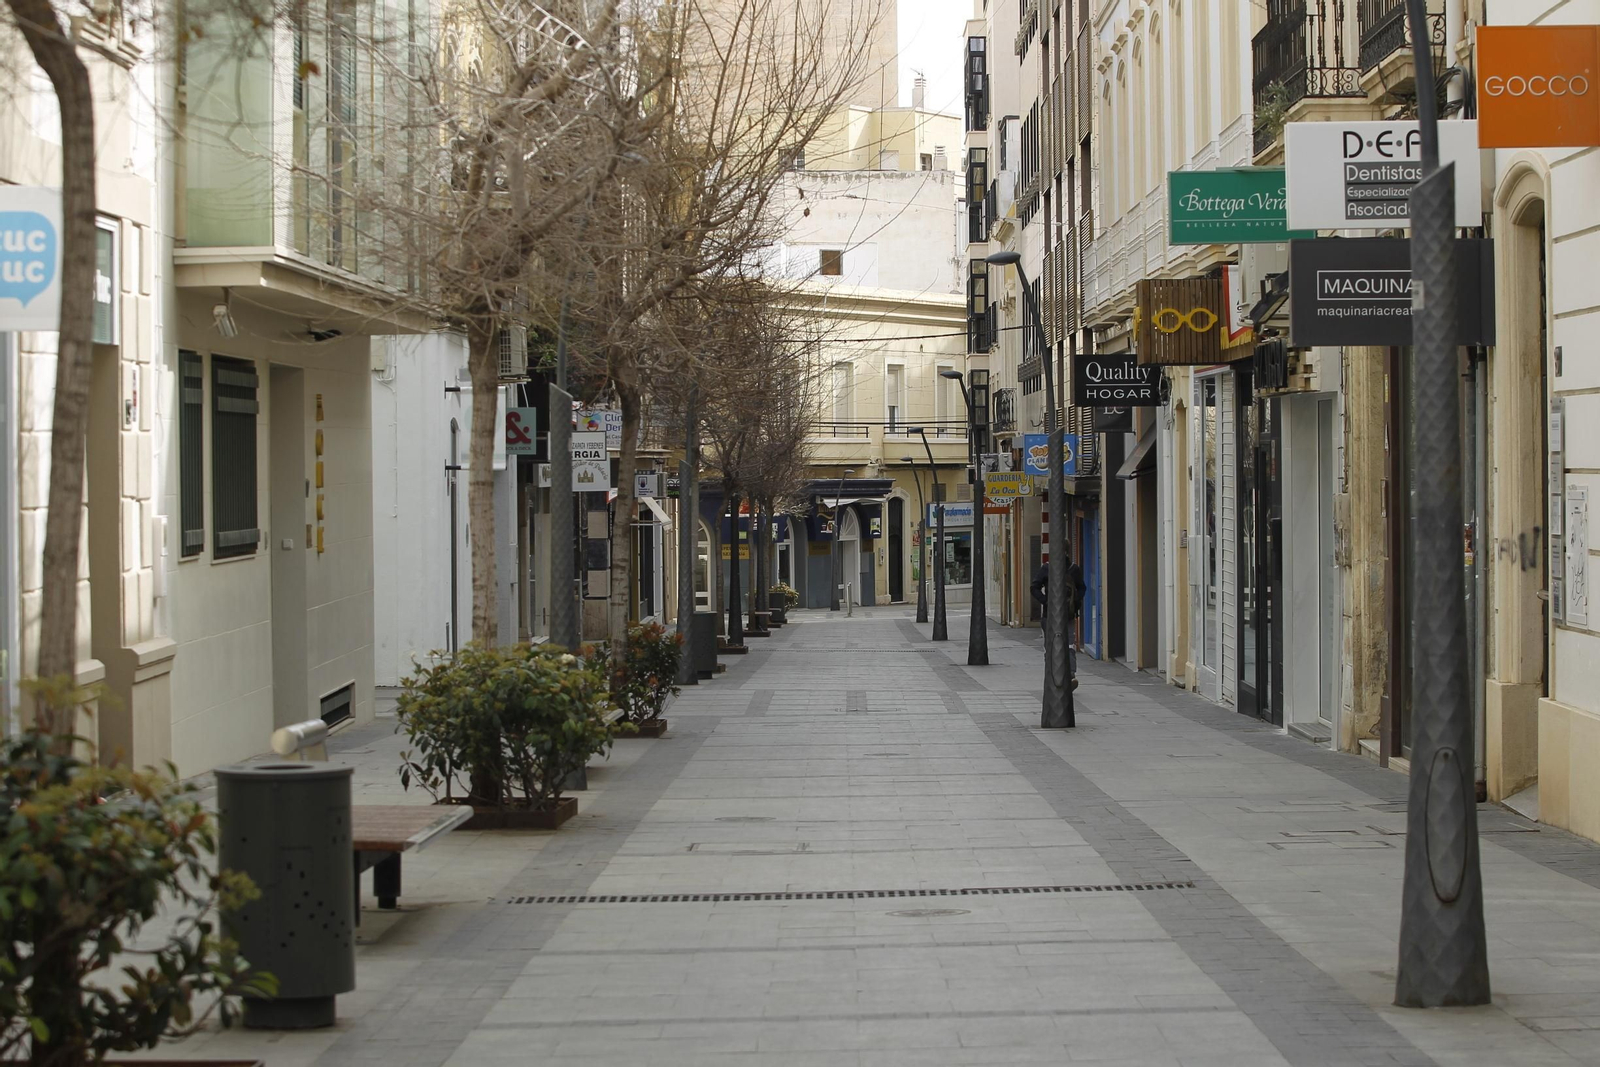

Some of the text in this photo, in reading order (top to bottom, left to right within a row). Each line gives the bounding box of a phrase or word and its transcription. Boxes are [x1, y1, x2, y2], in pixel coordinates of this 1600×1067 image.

[1484, 75, 1589, 97] GOCCO
[1346, 164, 1422, 181] Dentistas
[1178, 188, 1245, 218] Bottega
[1347, 202, 1411, 216] Asociad
[0, 229, 46, 252] uc
[0, 260, 45, 283] uc
[1085, 361, 1151, 384] Quality
[1086, 389, 1151, 399] HOGAR
[571, 450, 601, 459] RGIA
[988, 474, 1022, 483] GUARDERIA
[990, 486, 1016, 494] La Oca
